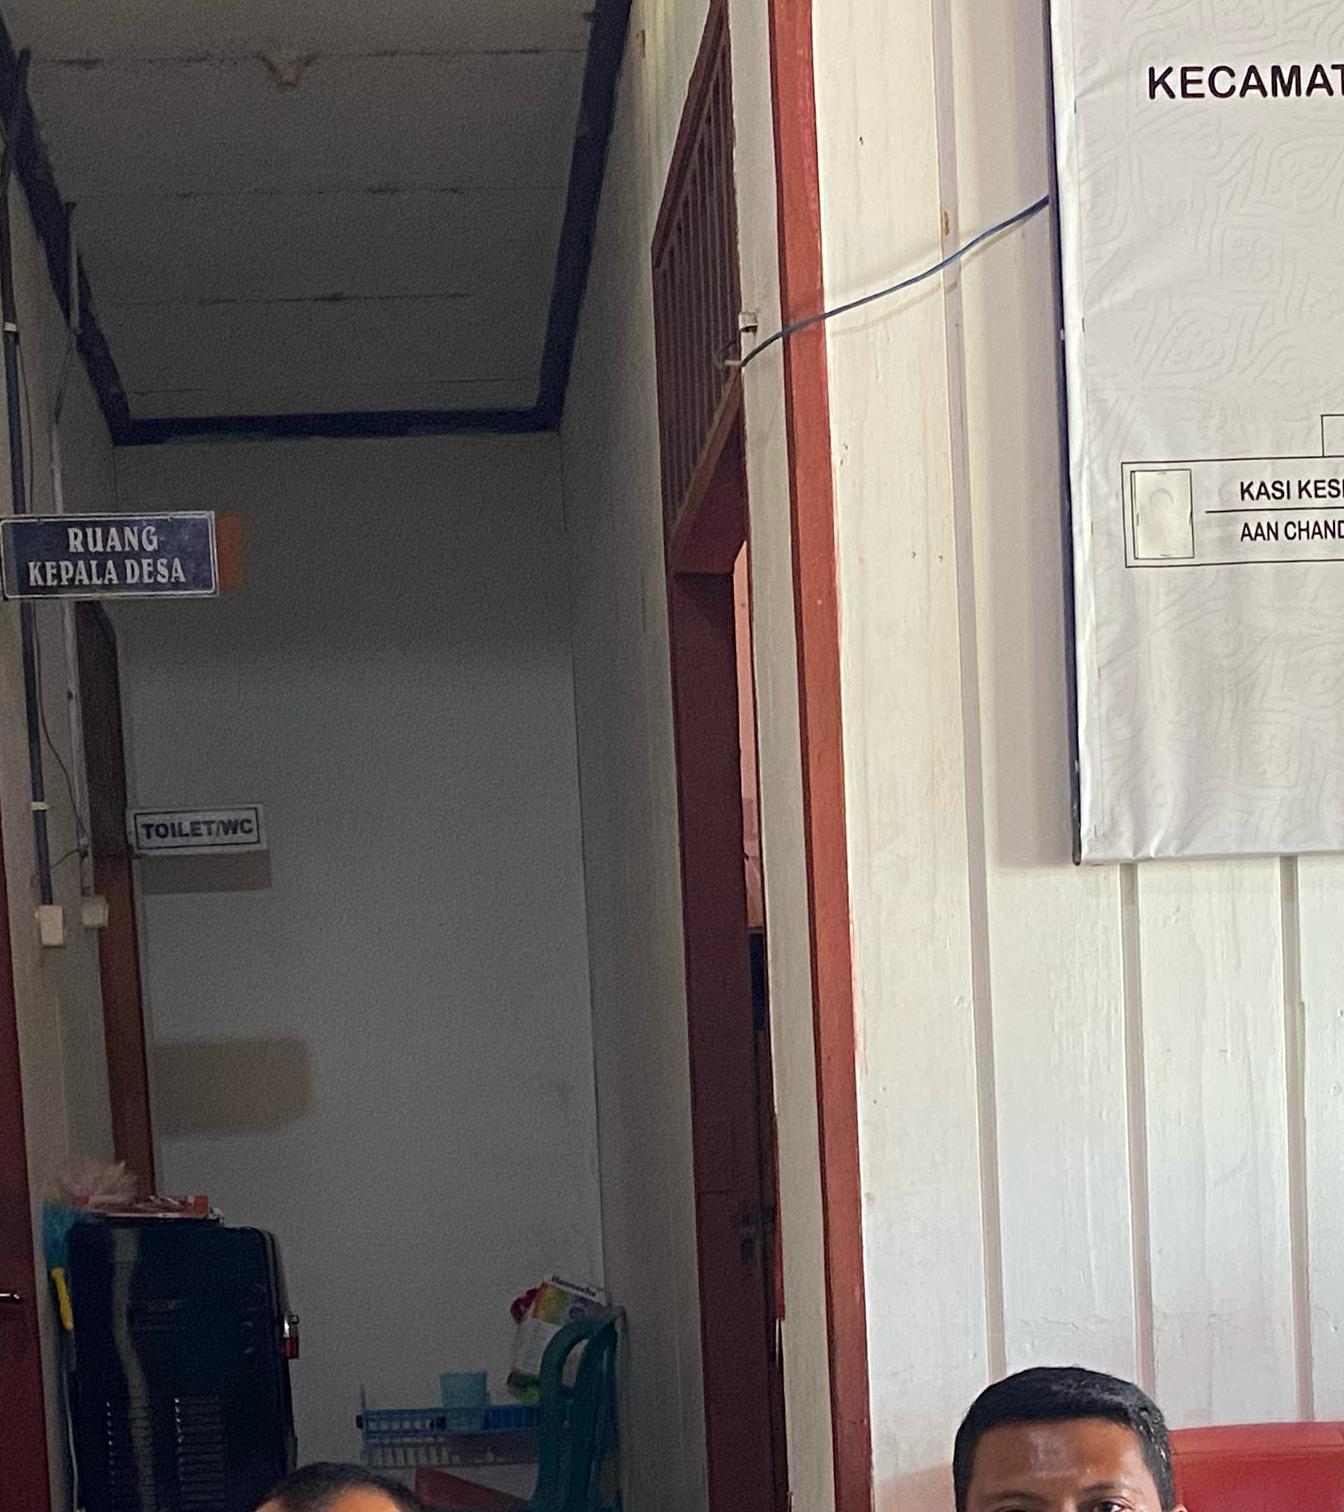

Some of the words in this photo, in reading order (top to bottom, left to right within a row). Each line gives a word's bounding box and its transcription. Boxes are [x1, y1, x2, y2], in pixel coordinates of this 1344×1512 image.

[1240, 479, 1291, 501] KASI
[67, 526, 159, 552] RUANG
[1240, 520, 1279, 542] AAN
[27, 559, 119, 586] KEPALA
[124, 557, 186, 584] DESA
[142, 819, 253, 839] TOILET/WC
